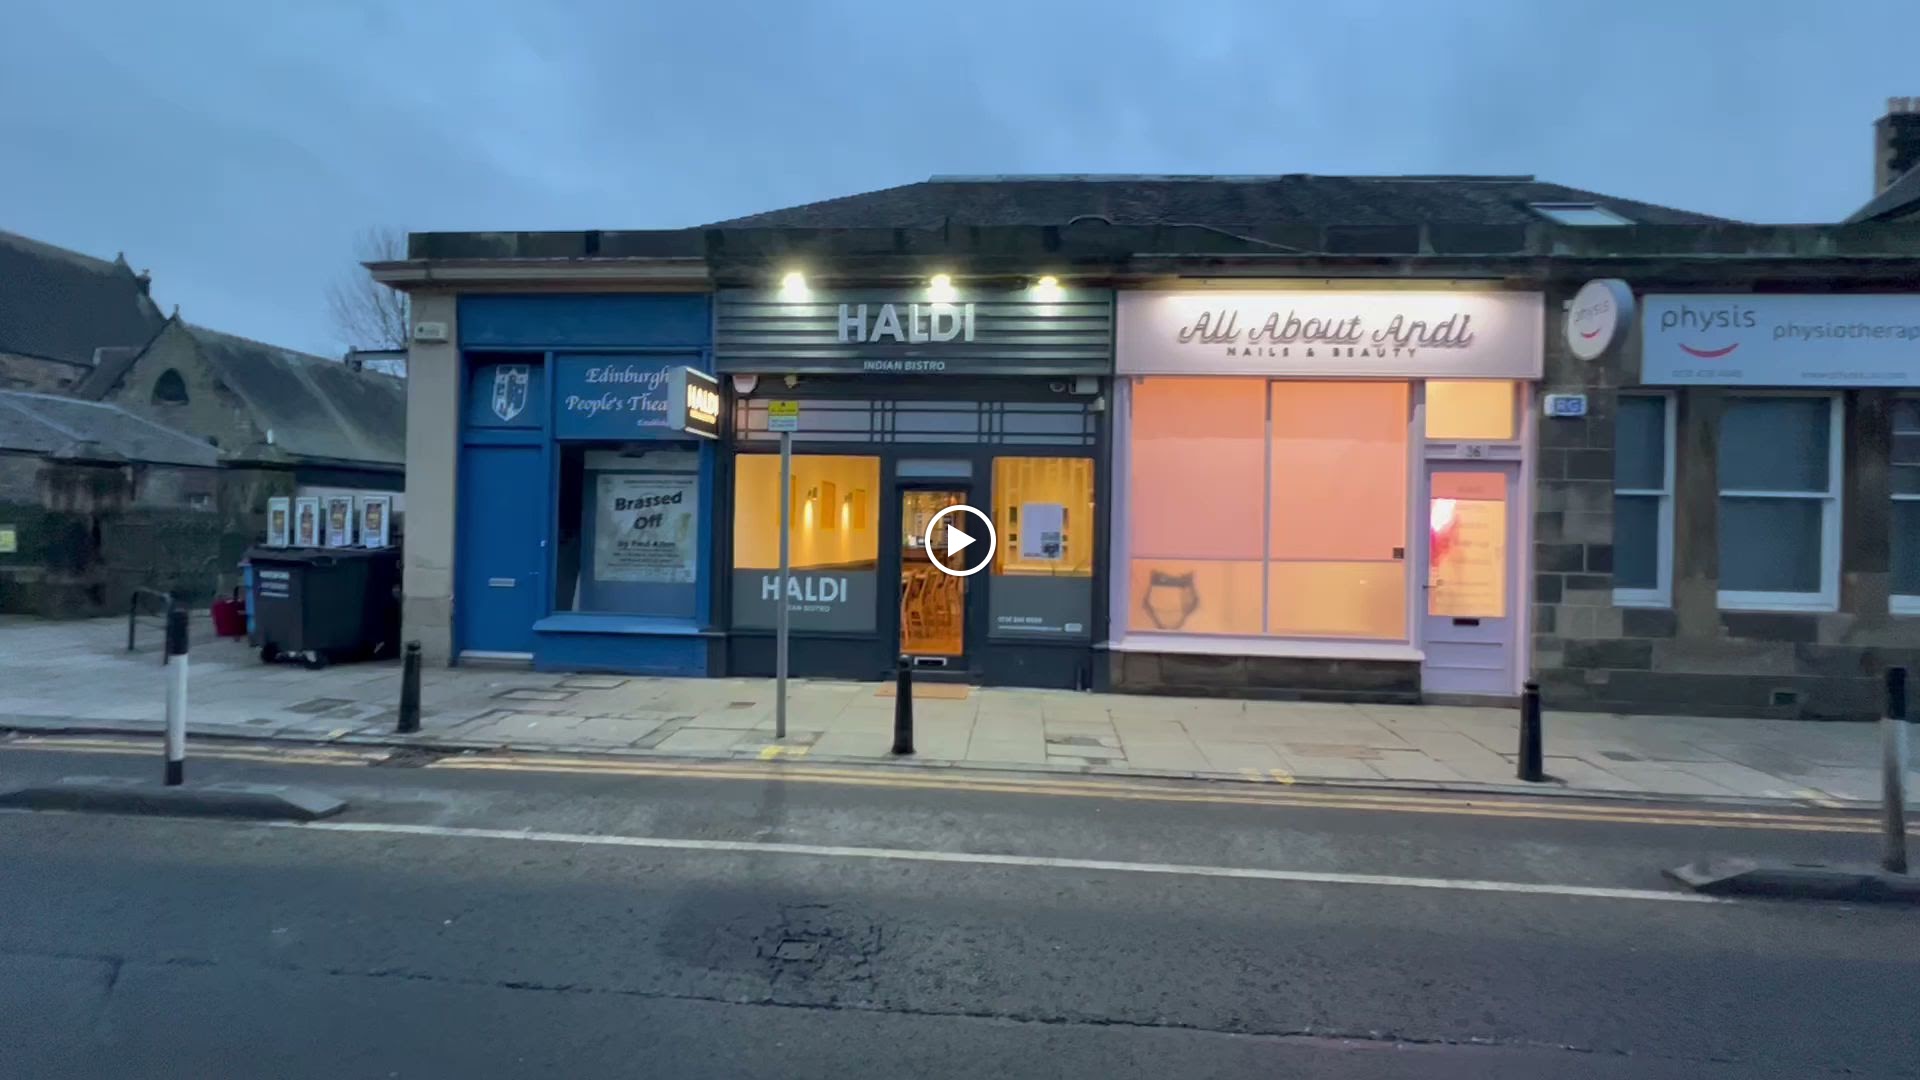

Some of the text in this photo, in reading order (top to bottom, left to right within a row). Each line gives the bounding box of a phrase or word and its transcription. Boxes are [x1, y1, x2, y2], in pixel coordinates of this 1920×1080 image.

[838, 302, 975, 343] HALDI
[1178, 309, 1241, 344] All
[1248, 309, 1364, 344] About
[1660, 303, 1757, 333] physis
[863, 360, 946, 372] INDIAN BISTRO
[1226, 347, 1417, 358] NAILS & BEAUTY
[585, 364, 670, 391] Edinburgh
[564, 391, 669, 418] People's Thea
[614, 490, 683, 512] Brassed
[633, 513, 664, 530] Off
[761, 575, 848, 603] HALDI
